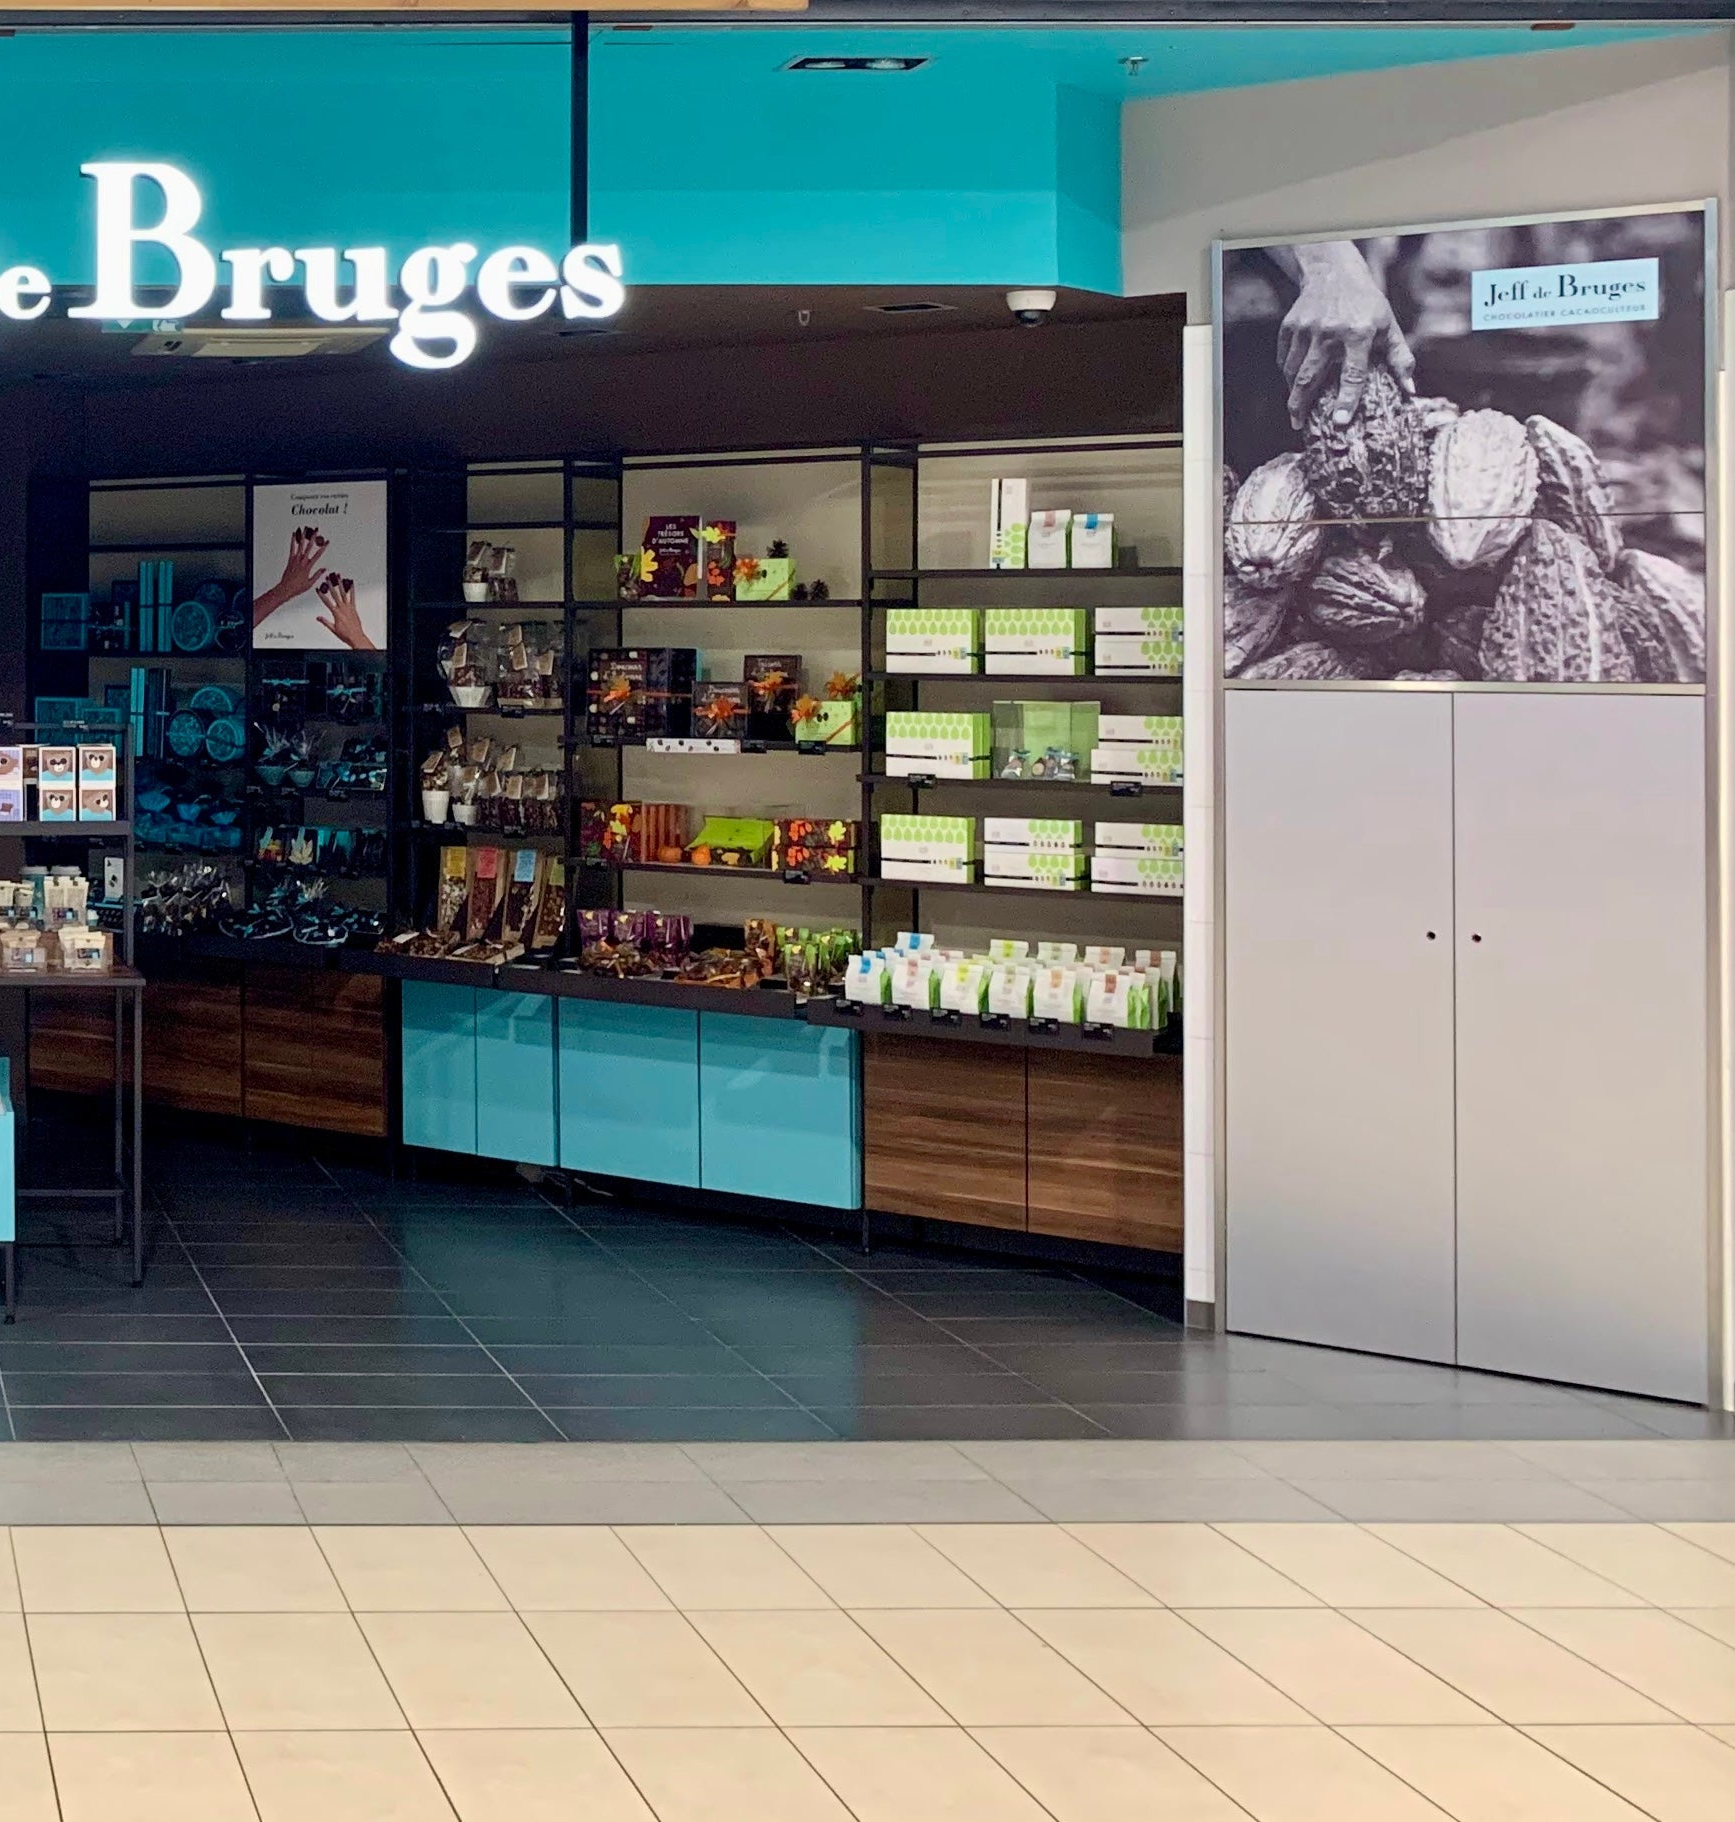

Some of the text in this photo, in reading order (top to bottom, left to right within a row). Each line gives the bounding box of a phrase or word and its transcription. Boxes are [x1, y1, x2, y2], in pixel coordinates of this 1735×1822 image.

[67, 162, 626, 369] Bruges
[1483, 273, 1647, 308] Jeff de Bruges
[1483, 304, 1647, 322] CHOCOLATIER CACAOCULTEUR
[291, 503, 340, 516] Chocolat
